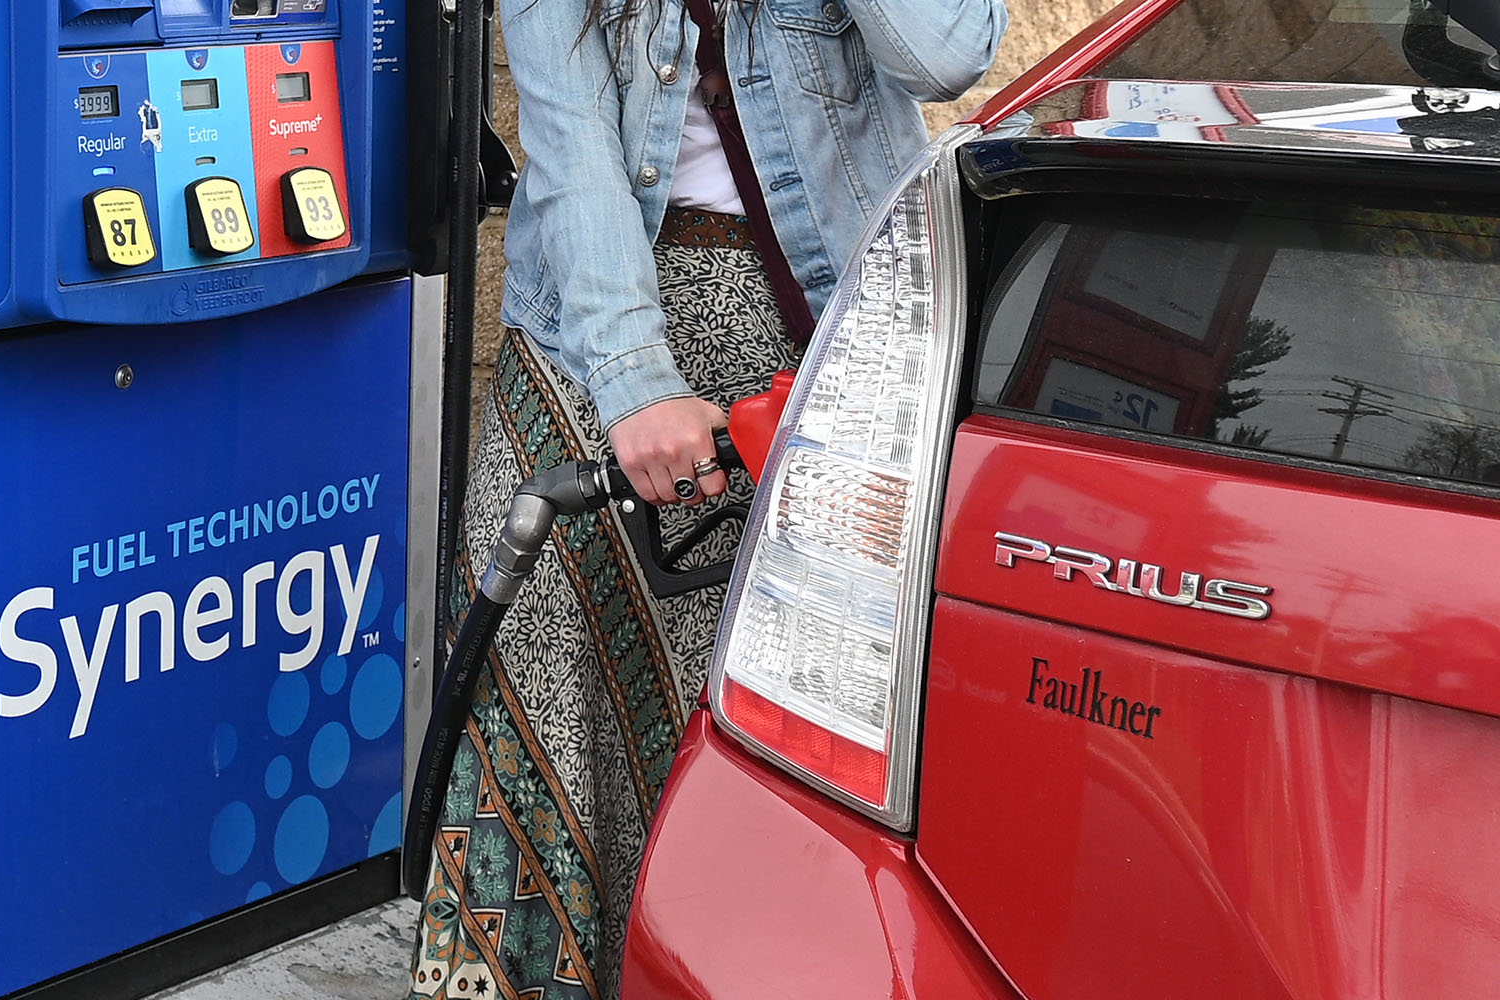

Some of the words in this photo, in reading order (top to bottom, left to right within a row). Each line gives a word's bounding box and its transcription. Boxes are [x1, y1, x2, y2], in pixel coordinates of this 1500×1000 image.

[74, 99, 79, 109] $
[78, 132, 126, 156] Regular
[188, 126, 218, 143] Extra
[211, 207, 239, 234] 89
[306, 196, 333, 222] 93
[110, 219, 136, 246] 87
[73, 530, 156, 582] FUEL
[167, 475, 380, 557] TECHNOLOGY
[994, 531, 1273, 620] PRIUS
[1026, 657, 1161, 738] Faulkner
